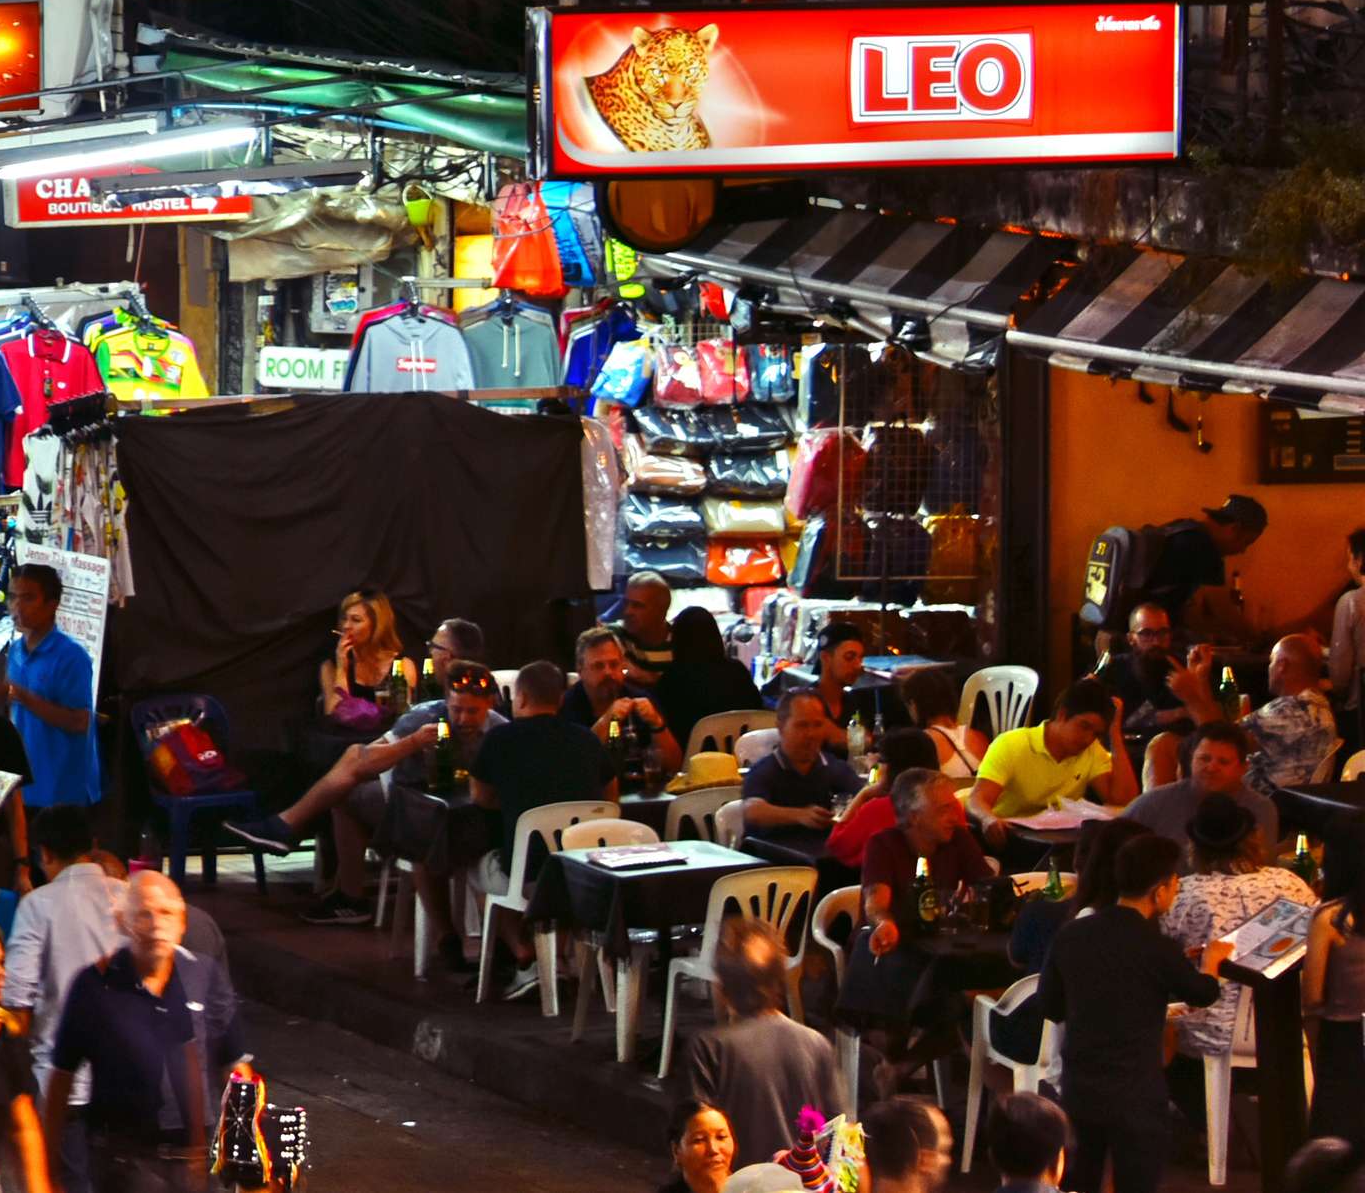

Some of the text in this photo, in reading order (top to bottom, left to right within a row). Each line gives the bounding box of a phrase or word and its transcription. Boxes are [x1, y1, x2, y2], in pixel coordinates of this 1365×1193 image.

[863, 41, 1023, 113] LEO
[132, 197, 190, 212] HOSTEL
[265, 357, 324, 380] ROOM
[71, 556, 107, 575] Massage
